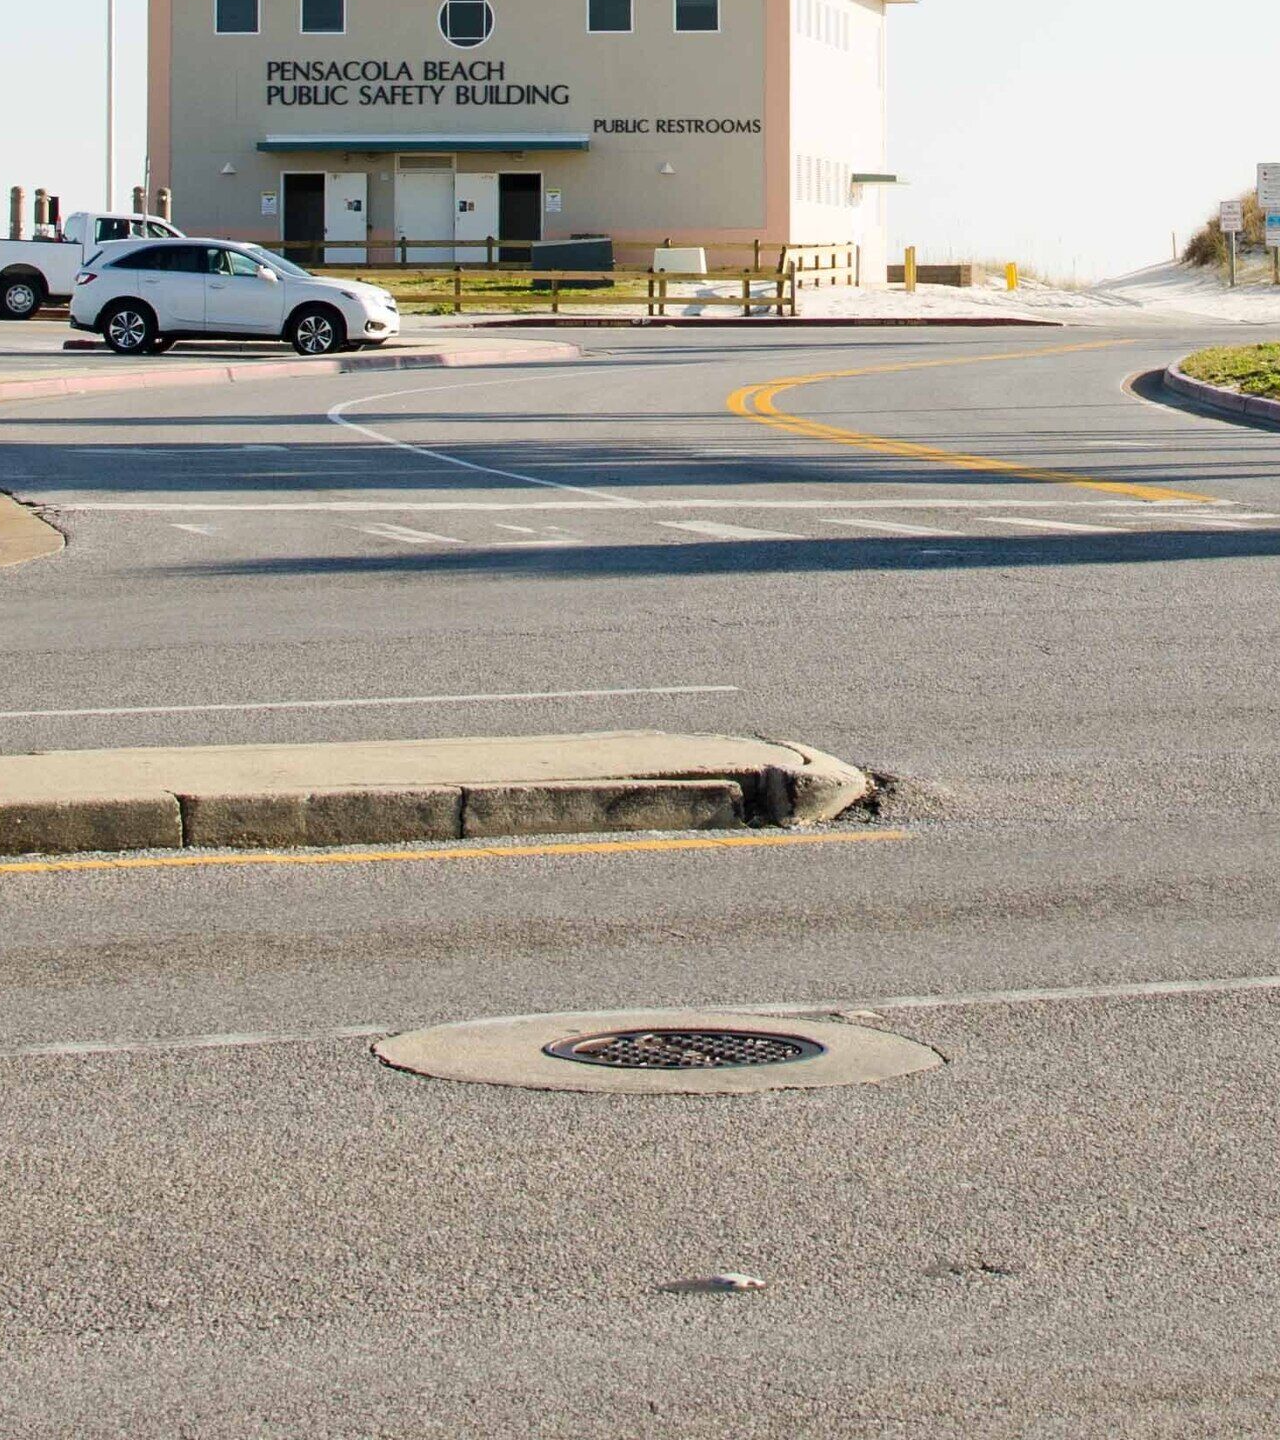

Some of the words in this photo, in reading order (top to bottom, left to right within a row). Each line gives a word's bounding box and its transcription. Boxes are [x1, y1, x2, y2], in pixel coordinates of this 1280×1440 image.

[266, 61, 413, 82] PENSACOLA
[423, 61, 505, 81] BEACH
[266, 85, 348, 105] PUBLIC
[359, 85, 446, 105] SAFETY
[456, 85, 570, 105] BUILDING
[593, 119, 650, 134] PUBLIC
[656, 119, 761, 134] RESTROOMS
